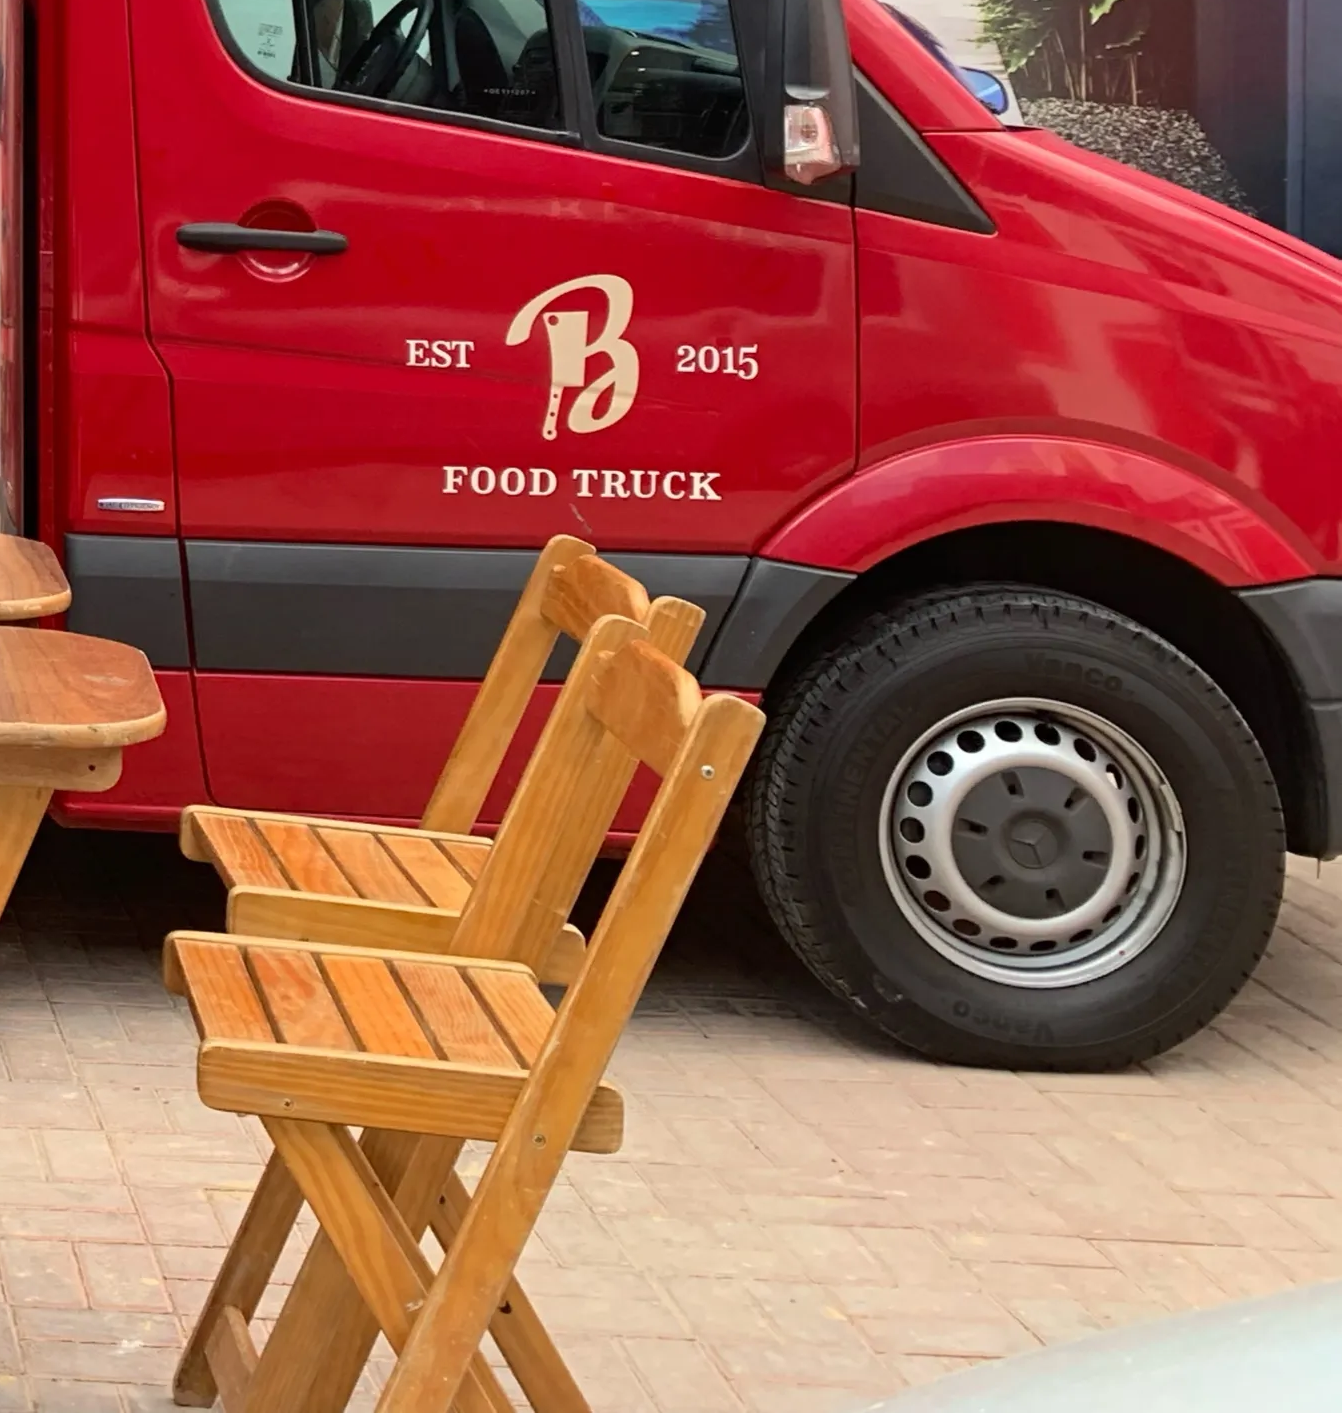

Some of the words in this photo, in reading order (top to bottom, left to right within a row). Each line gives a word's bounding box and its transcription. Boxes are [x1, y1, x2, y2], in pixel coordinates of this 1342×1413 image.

[405, 339, 475, 369] EST
[676, 344, 759, 380] 2015
[505, 273, 640, 441] B
[442, 465, 558, 497] FOOD
[572, 469, 723, 501] TRUCK
